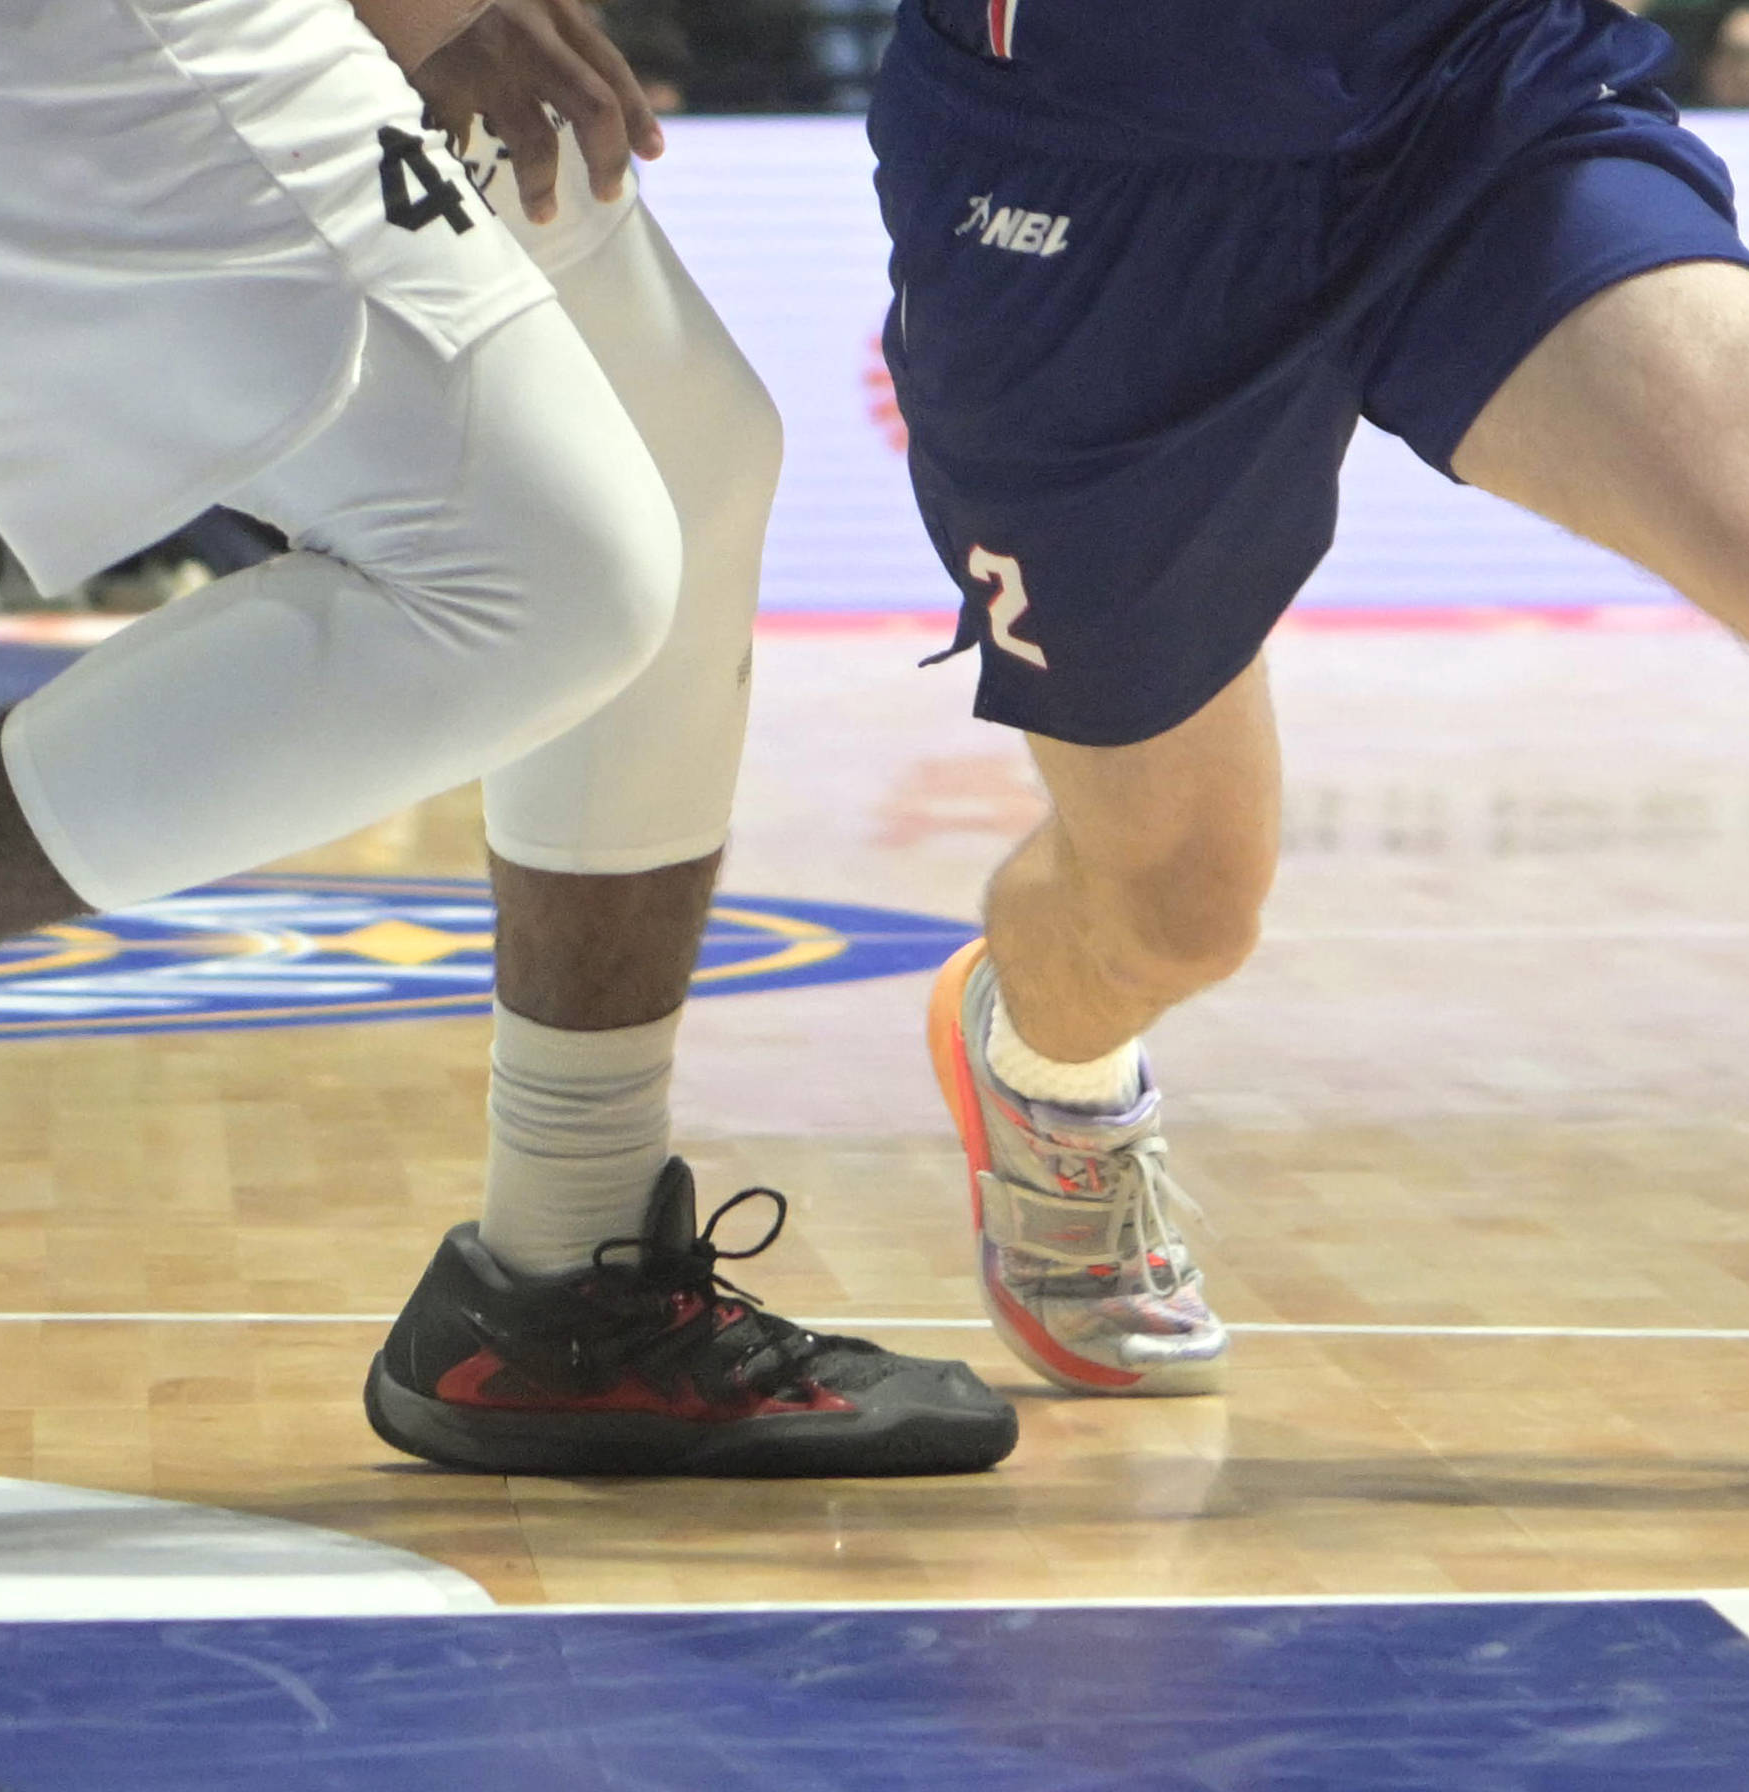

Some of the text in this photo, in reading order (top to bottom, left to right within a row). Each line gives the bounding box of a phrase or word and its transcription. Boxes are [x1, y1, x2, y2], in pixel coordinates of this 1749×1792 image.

[377, 124, 475, 235] 4
[981, 206, 1072, 258] NBL
[967, 544, 1048, 670] 2
